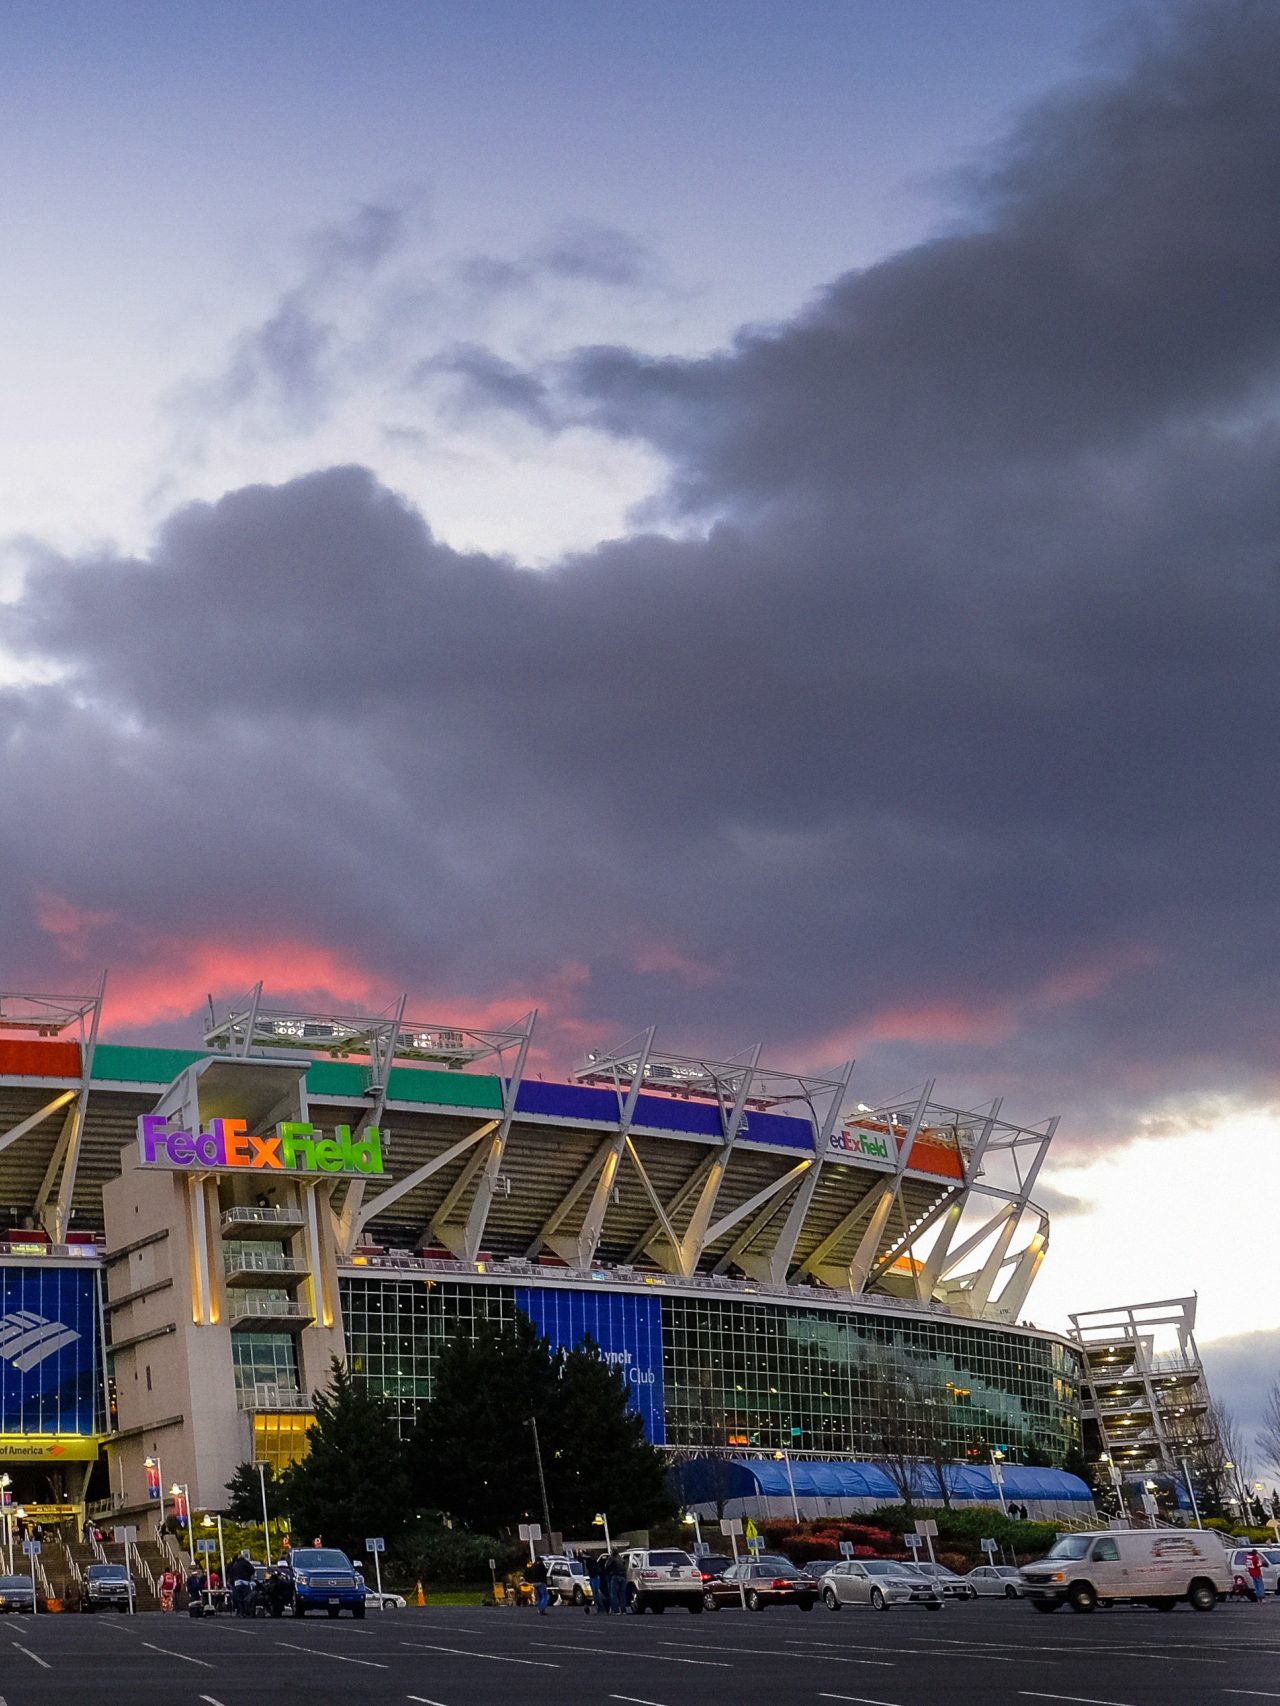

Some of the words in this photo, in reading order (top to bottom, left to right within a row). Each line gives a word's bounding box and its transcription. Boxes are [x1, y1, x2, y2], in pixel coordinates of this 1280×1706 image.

[137, 1114, 384, 1174] FedExField
[830, 1130, 888, 1158] edExField
[629, 1367, 655, 1384] Club
[0, 1446, 8, 1455] of
[9, 1446, 43, 1455] America
